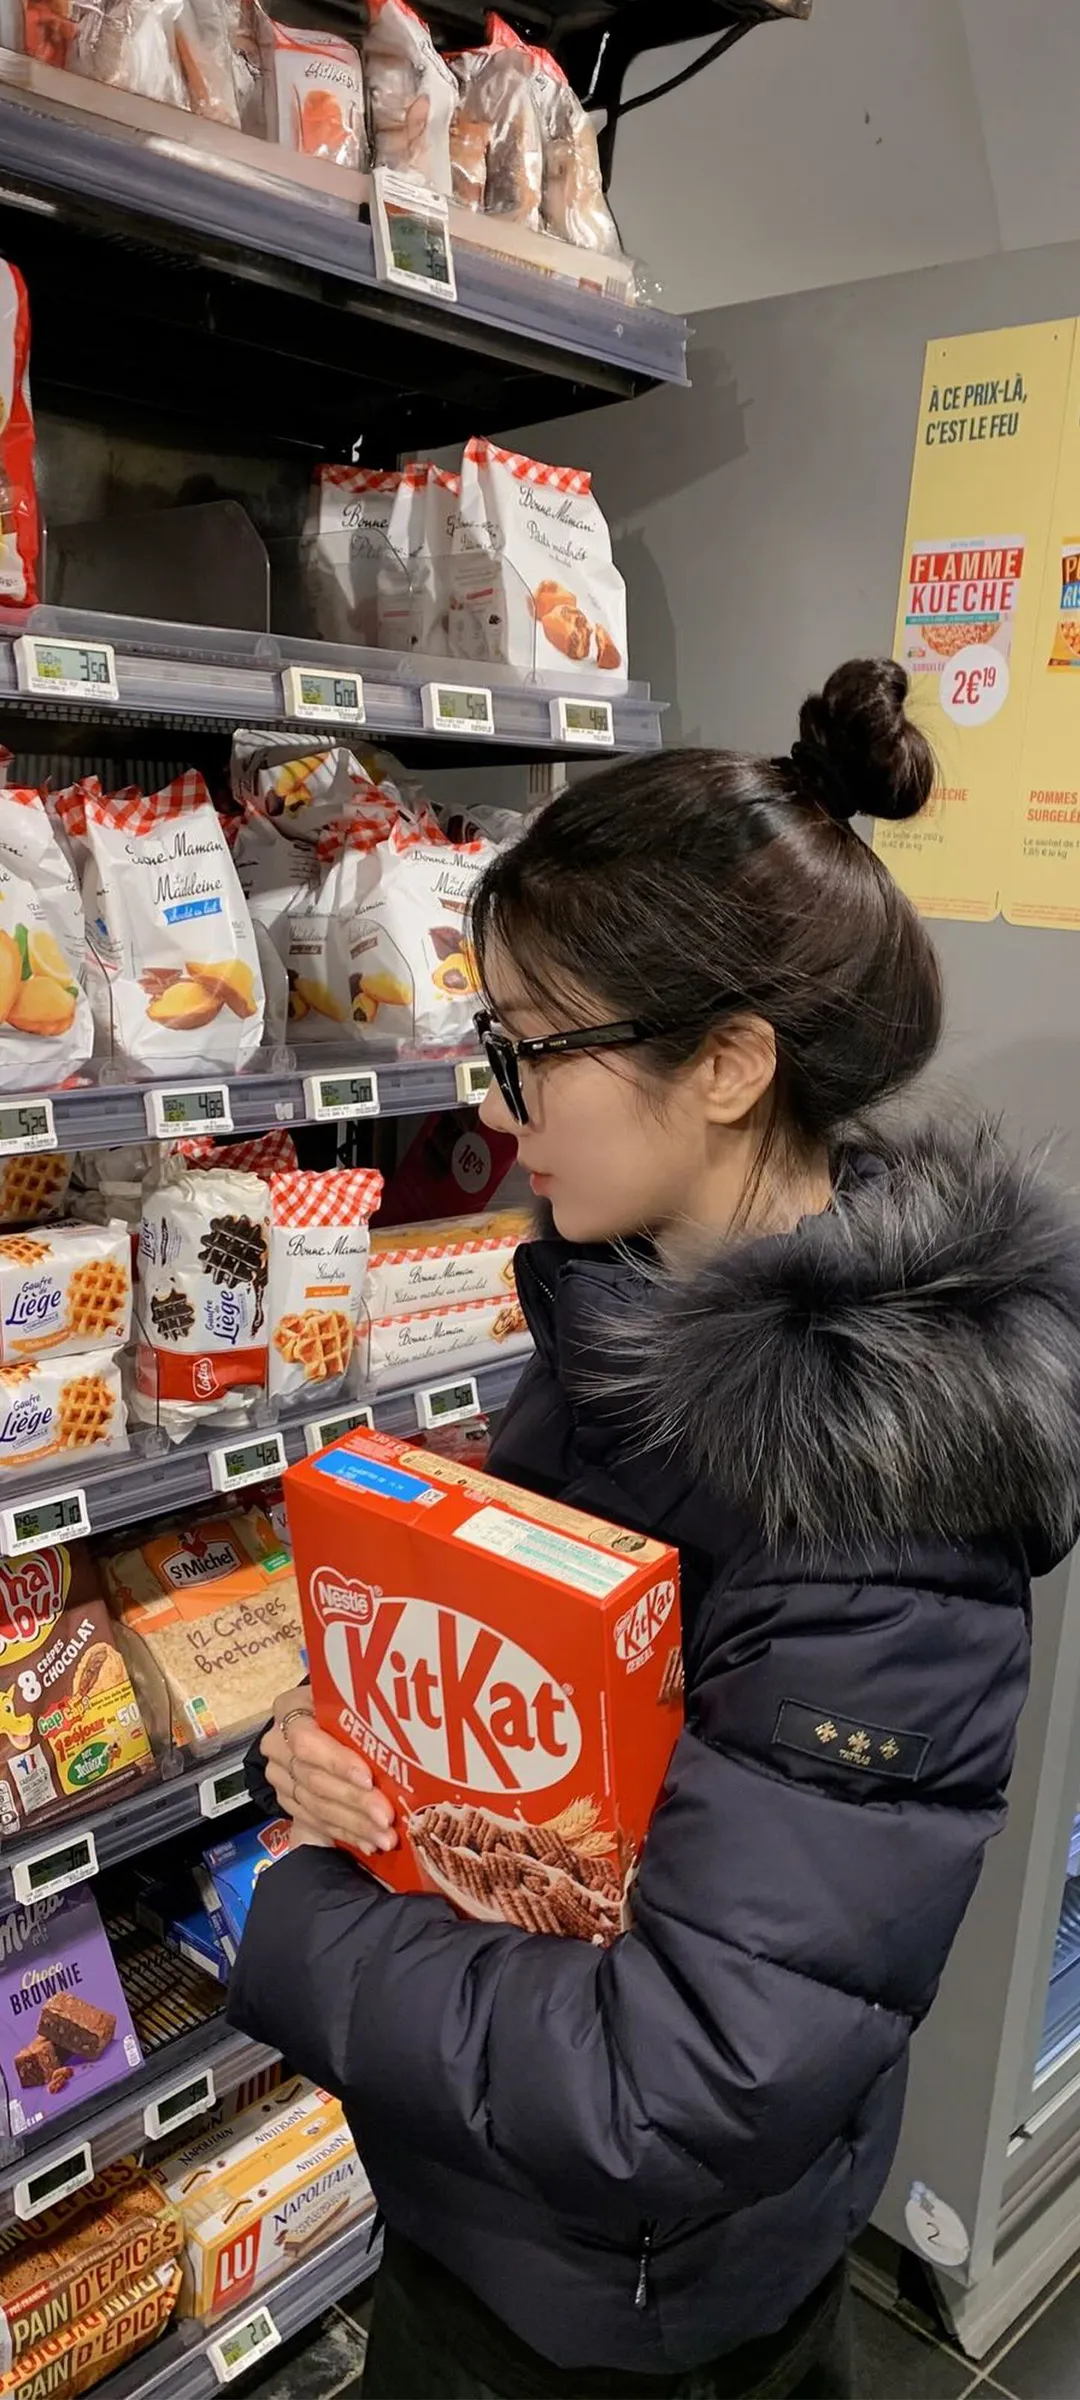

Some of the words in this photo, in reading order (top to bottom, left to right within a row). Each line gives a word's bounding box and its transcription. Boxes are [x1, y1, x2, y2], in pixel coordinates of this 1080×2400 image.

[928, 384, 939, 413] À
[942, 386, 962, 411] CE
[963, 373, 1027, 408] PRIX-LÀ,
[926, 418, 967, 446] C'EST
[969, 417, 988, 441] LE
[989, 412, 1019, 439] FEU
[341, 501, 389, 528] Bonne
[914, 549, 1019, 583] FLAMME
[911, 581, 1014, 614] KUECHE
[1029, 790, 1079, 805] POMMES
[169, 831, 224, 859] Maman
[153, 872, 222, 905] Madeleine
[286, 1233, 325, 1257] Bonne
[21, 1275, 53, 1294] Gaufre
[408, 1265, 438, 1285] Bonne
[438, 1260, 474, 1280] Maman
[5, 1289, 62, 1326] Liège
[213, 1289, 241, 1346] Liège
[398, 1326, 428, 1347] Bonne
[429, 1321, 465, 1340] Maman
[13, 1394, 41, 1413] Gaufre
[0, 1406, 53, 1442] Liège
[183, 1545, 235, 1578] Michel
[187, 1629, 212, 1650] 12
[213, 1596, 287, 1638] Crêpes
[623, 1584, 674, 1658] KitKat
[36, 1638, 65, 1674] CRÊPES
[42, 1618, 96, 1689] CHOCOLAT
[194, 1619, 302, 1676] Bretonnes
[626, 1645, 655, 1676] CEREAL
[18, 1669, 43, 1703] 8
[344, 1602, 569, 1789] KitKat
[38, 1710, 64, 1735] Cap
[338, 1707, 415, 1793] CEREAL
[9, 1962, 83, 2017] BROWNIE
[21, 1961, 64, 1991] Choco
[254, 2107, 308, 2145] NAPOLITAIN
[178, 2127, 235, 2166] NAPOLITAIN
[295, 2133, 349, 2173] NAPOLITAIN
[273, 2162, 357, 2230] NAPOLITAIN
[220, 2234, 254, 2292] LU
[12, 2291, 69, 2355] PAIN
[75, 2220, 177, 2313] D'EPICES
